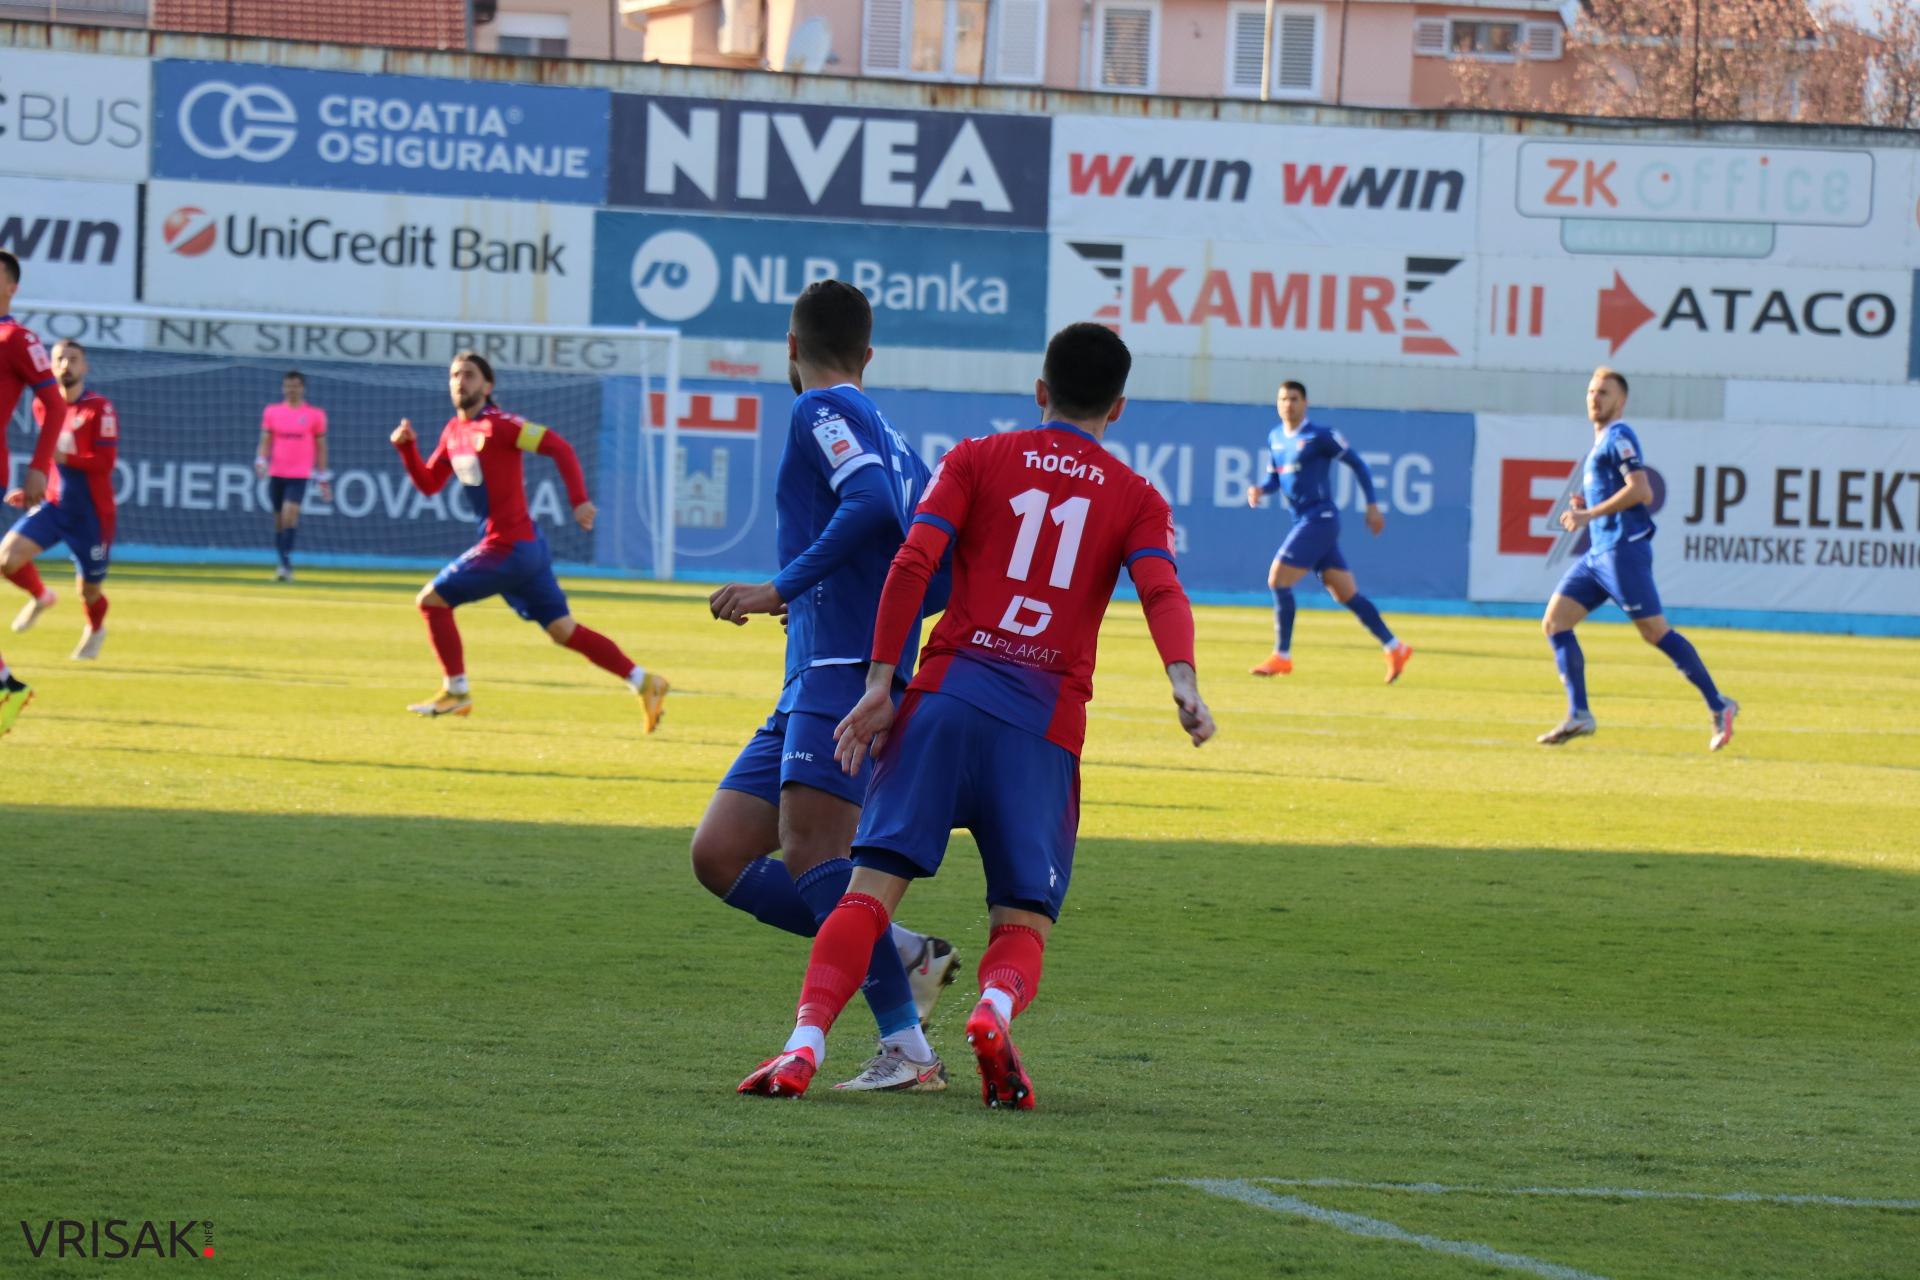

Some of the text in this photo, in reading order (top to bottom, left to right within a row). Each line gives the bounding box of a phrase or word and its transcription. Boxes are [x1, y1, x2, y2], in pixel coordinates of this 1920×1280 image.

[317, 135, 590, 178] OSIGURANJE
[645, 101, 1014, 213] NIVEA
[1543, 158, 1619, 208] ZK
[226, 214, 567, 276] UniCredit Bank
[853, 259, 1008, 314] Banka
[1130, 265, 1397, 335] KAMIR
[1660, 286, 1897, 338] ATACO
[1684, 465, 1748, 525] JP
[1007, 487, 1091, 590] 11
[1684, 535, 1920, 569] HRVATSKE ZAJEDNI
